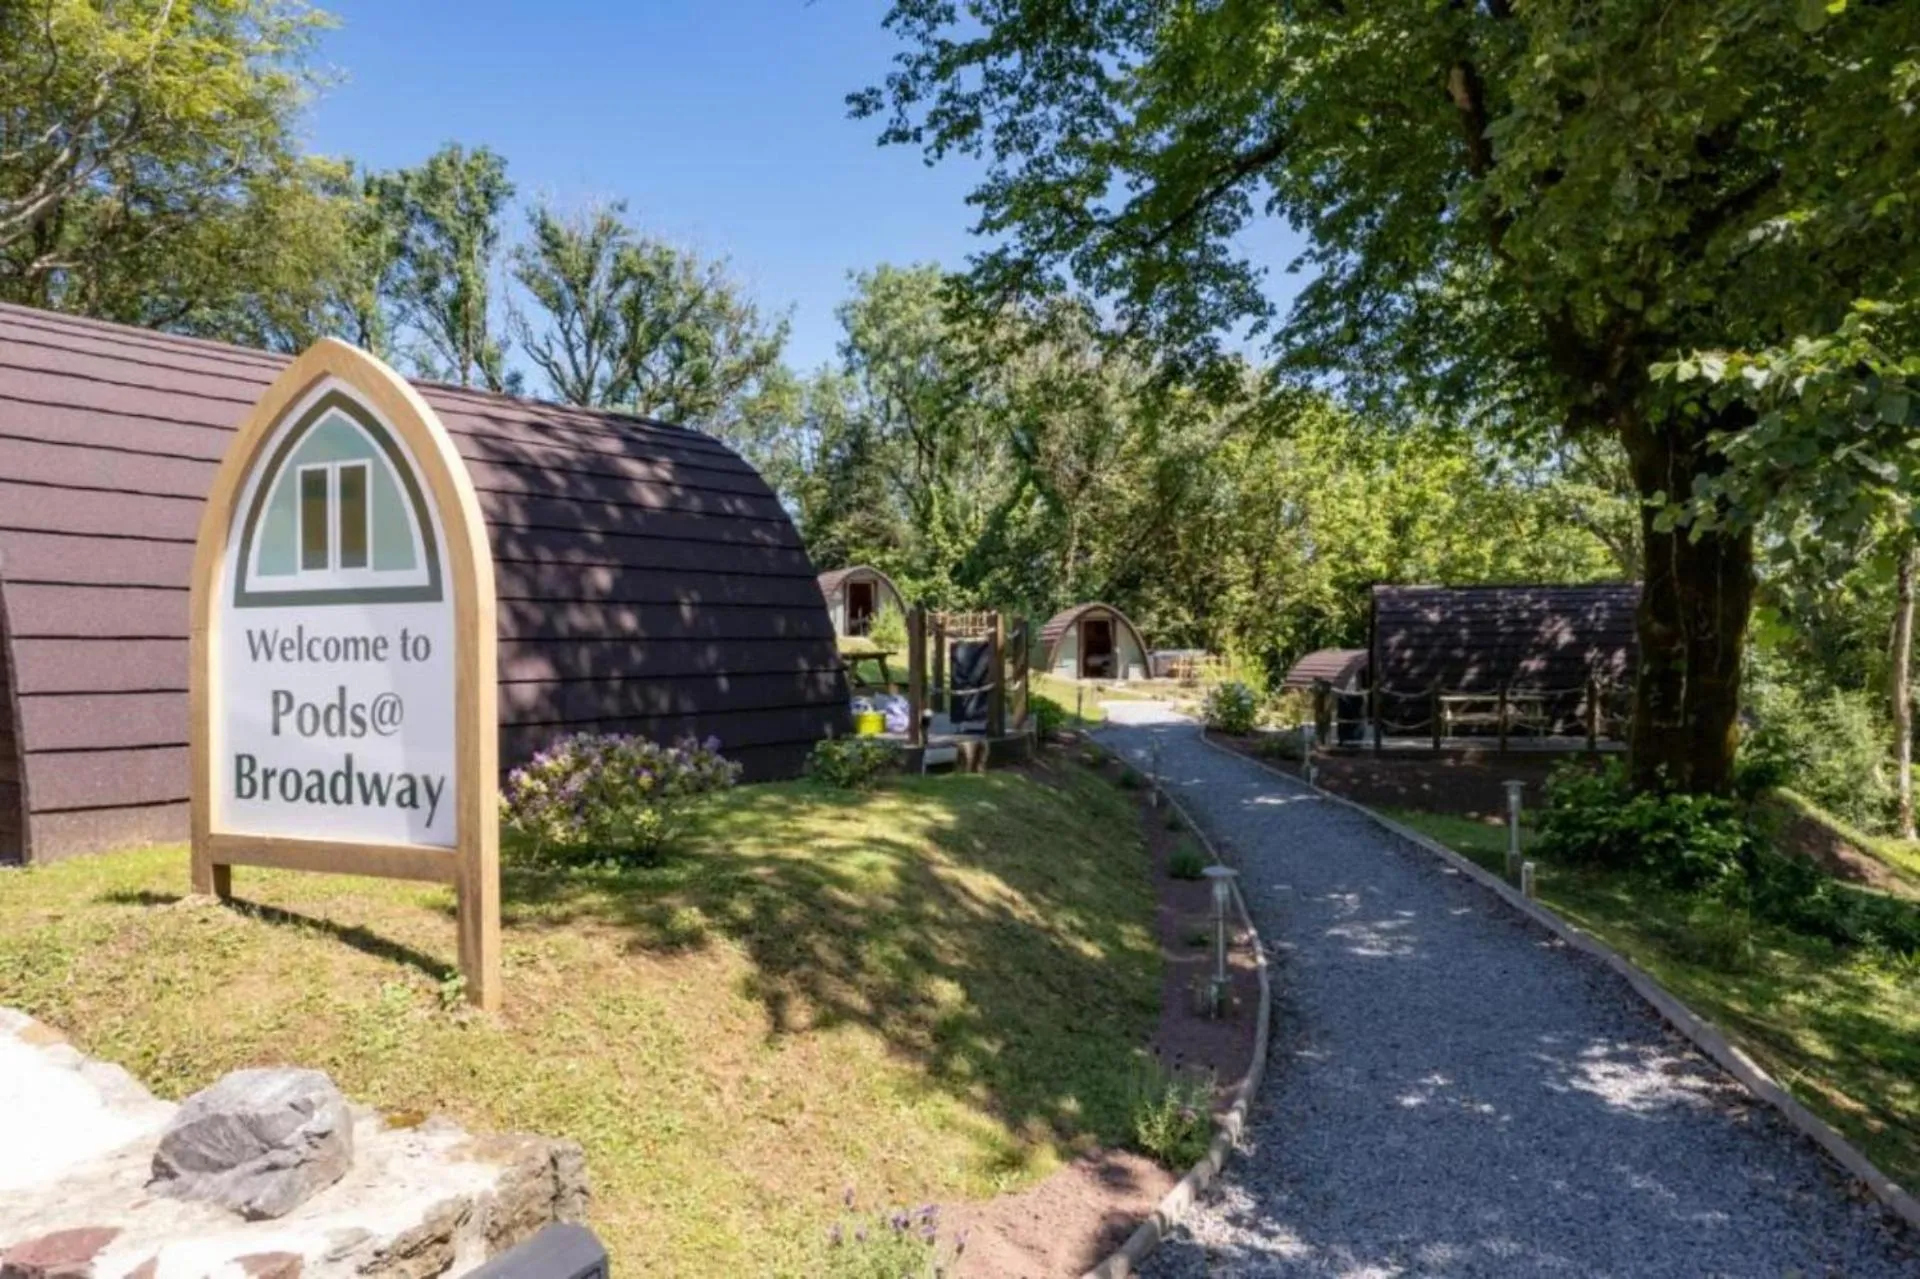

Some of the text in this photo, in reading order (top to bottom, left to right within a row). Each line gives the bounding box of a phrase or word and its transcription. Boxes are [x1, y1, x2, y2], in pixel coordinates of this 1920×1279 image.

[246, 625, 431, 662] Welcome to
[271, 685, 404, 738] Pods@
[234, 753, 445, 829] Broadway
